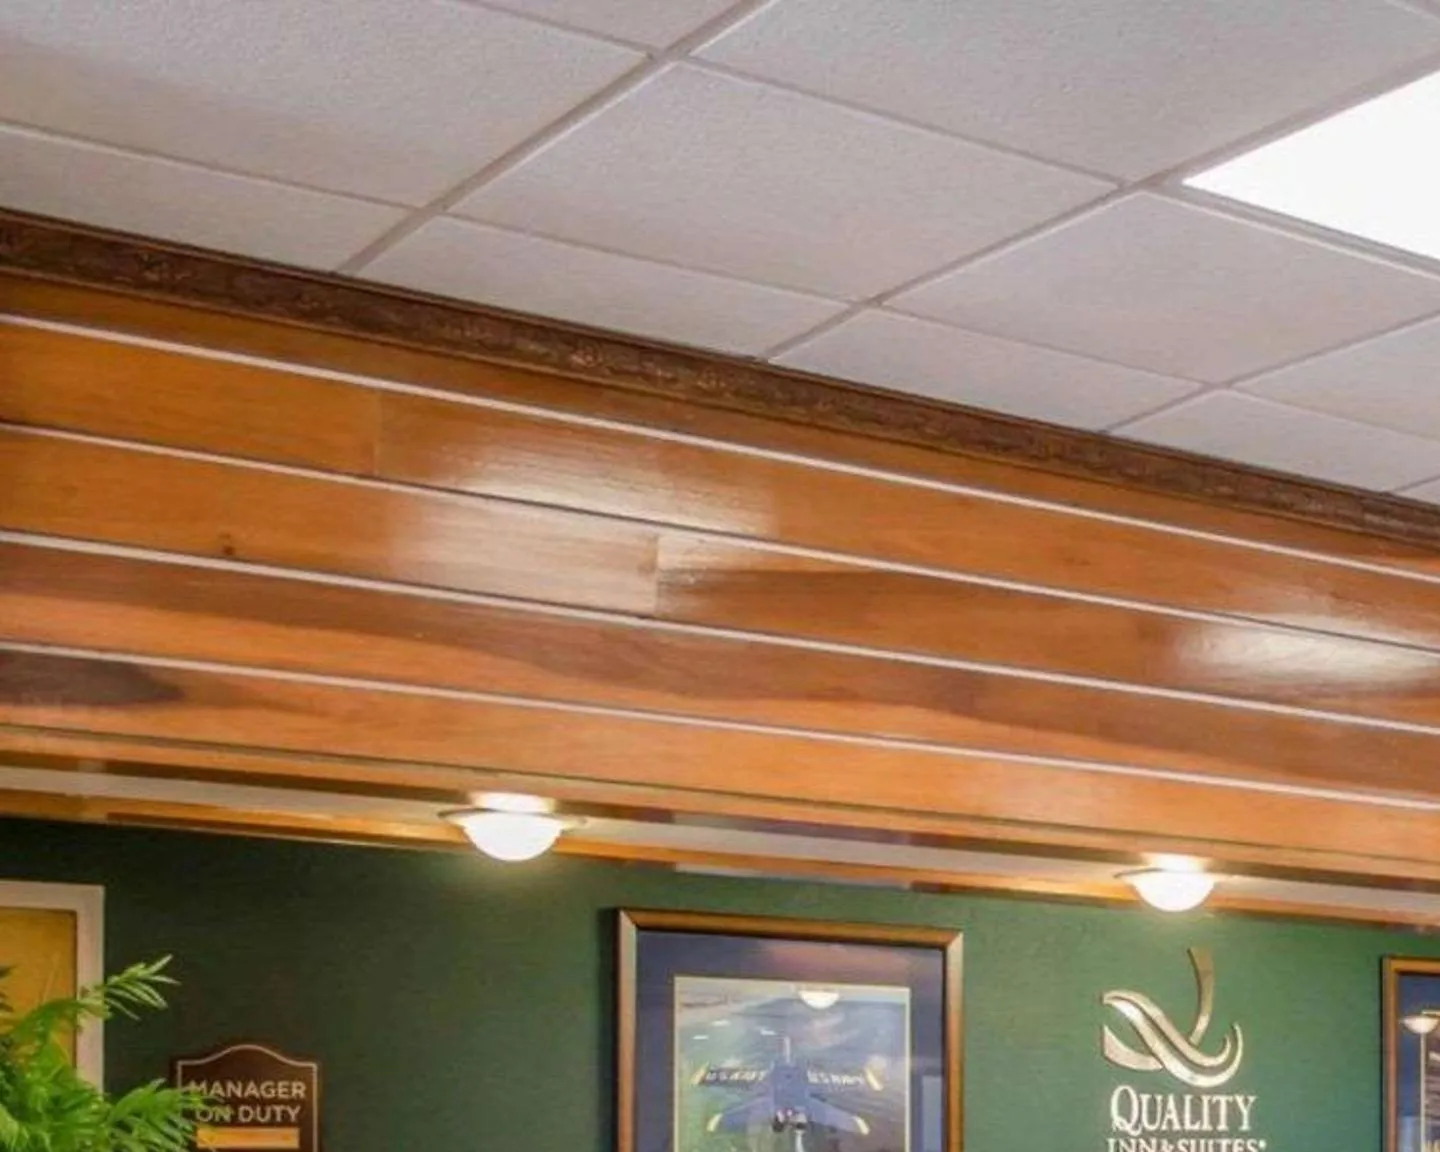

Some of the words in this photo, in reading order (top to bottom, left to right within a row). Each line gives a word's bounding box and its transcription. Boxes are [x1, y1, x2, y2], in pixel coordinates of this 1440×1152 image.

[188, 1080, 307, 1098] MANAGER
[195, 1104, 232, 1122] ON
[238, 1105, 301, 1122] DUTY
[1110, 1084, 1259, 1136] QUALITY
